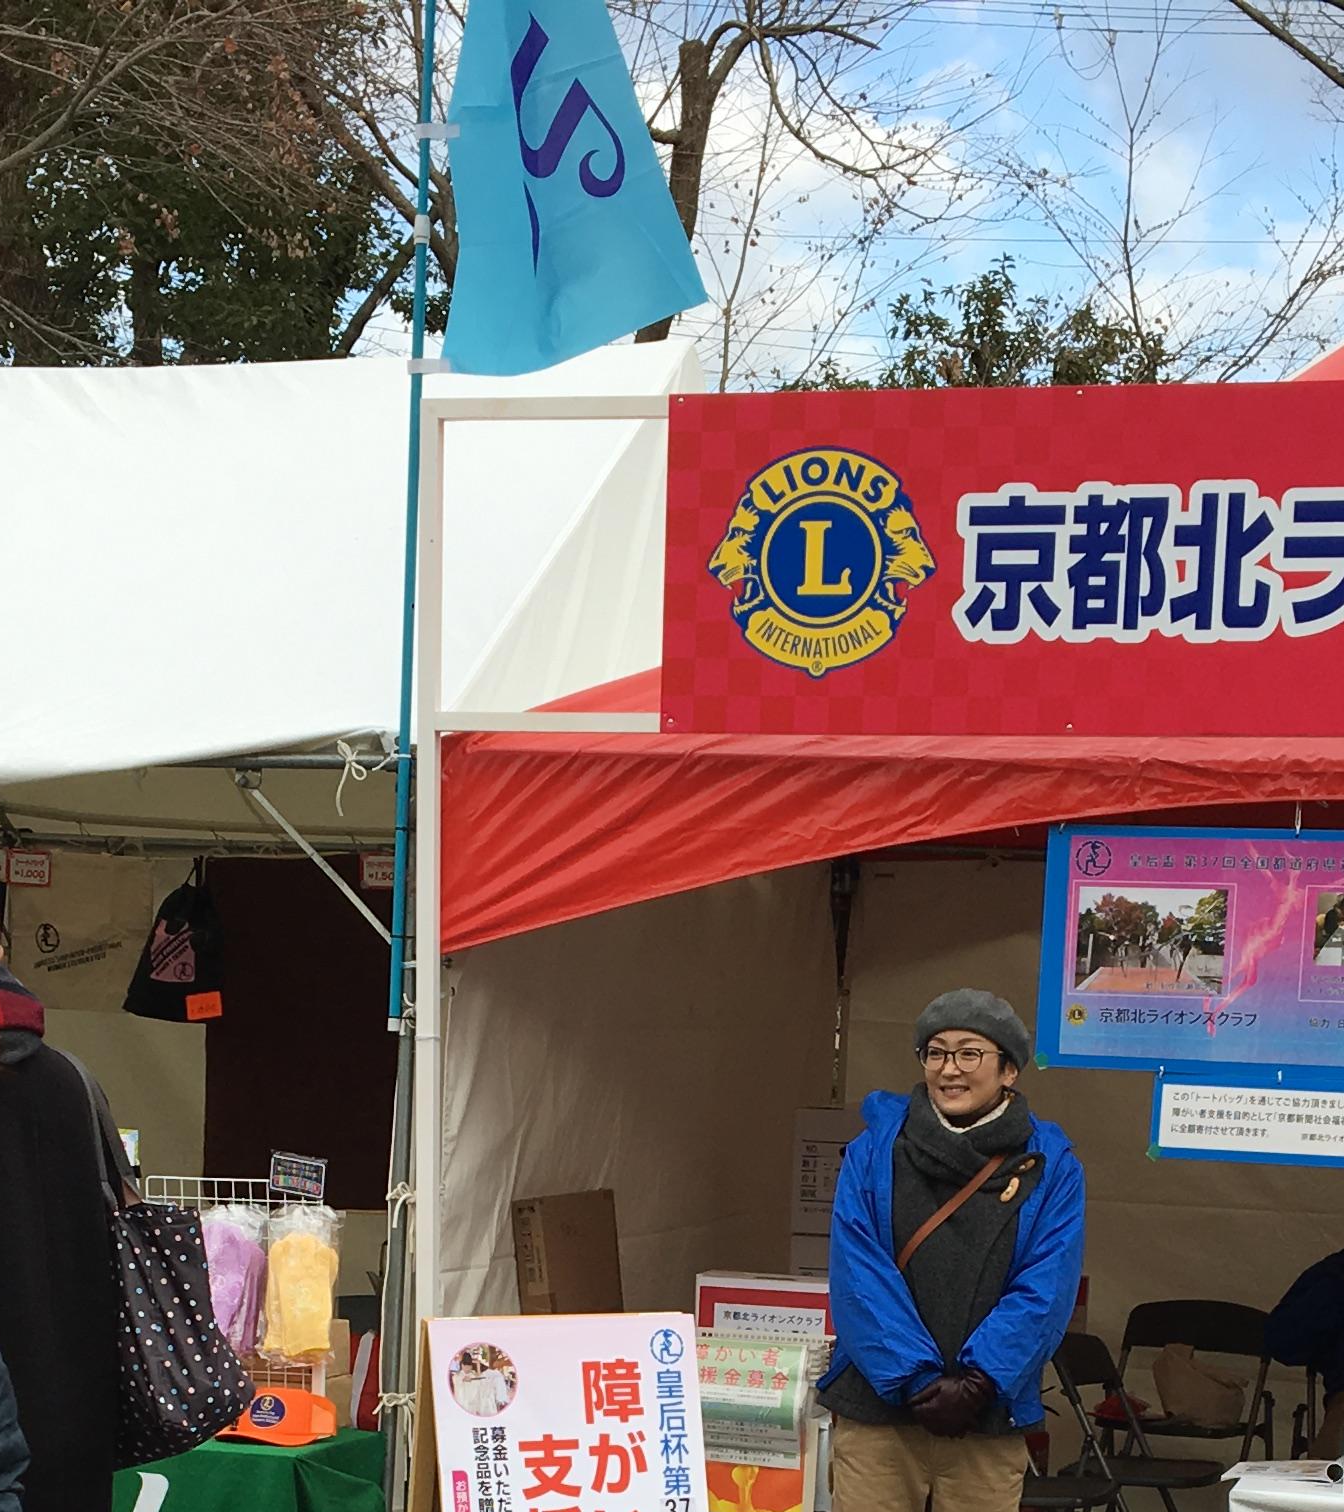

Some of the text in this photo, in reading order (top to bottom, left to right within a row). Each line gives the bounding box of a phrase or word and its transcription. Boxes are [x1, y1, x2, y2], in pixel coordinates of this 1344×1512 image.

[760, 456, 889, 505] LIONS
[797, 521, 852, 595] L
[756, 618, 882, 658] INTERNATIONAL
[723, 1310, 823, 1327] 京都北ライオンズクラブ
